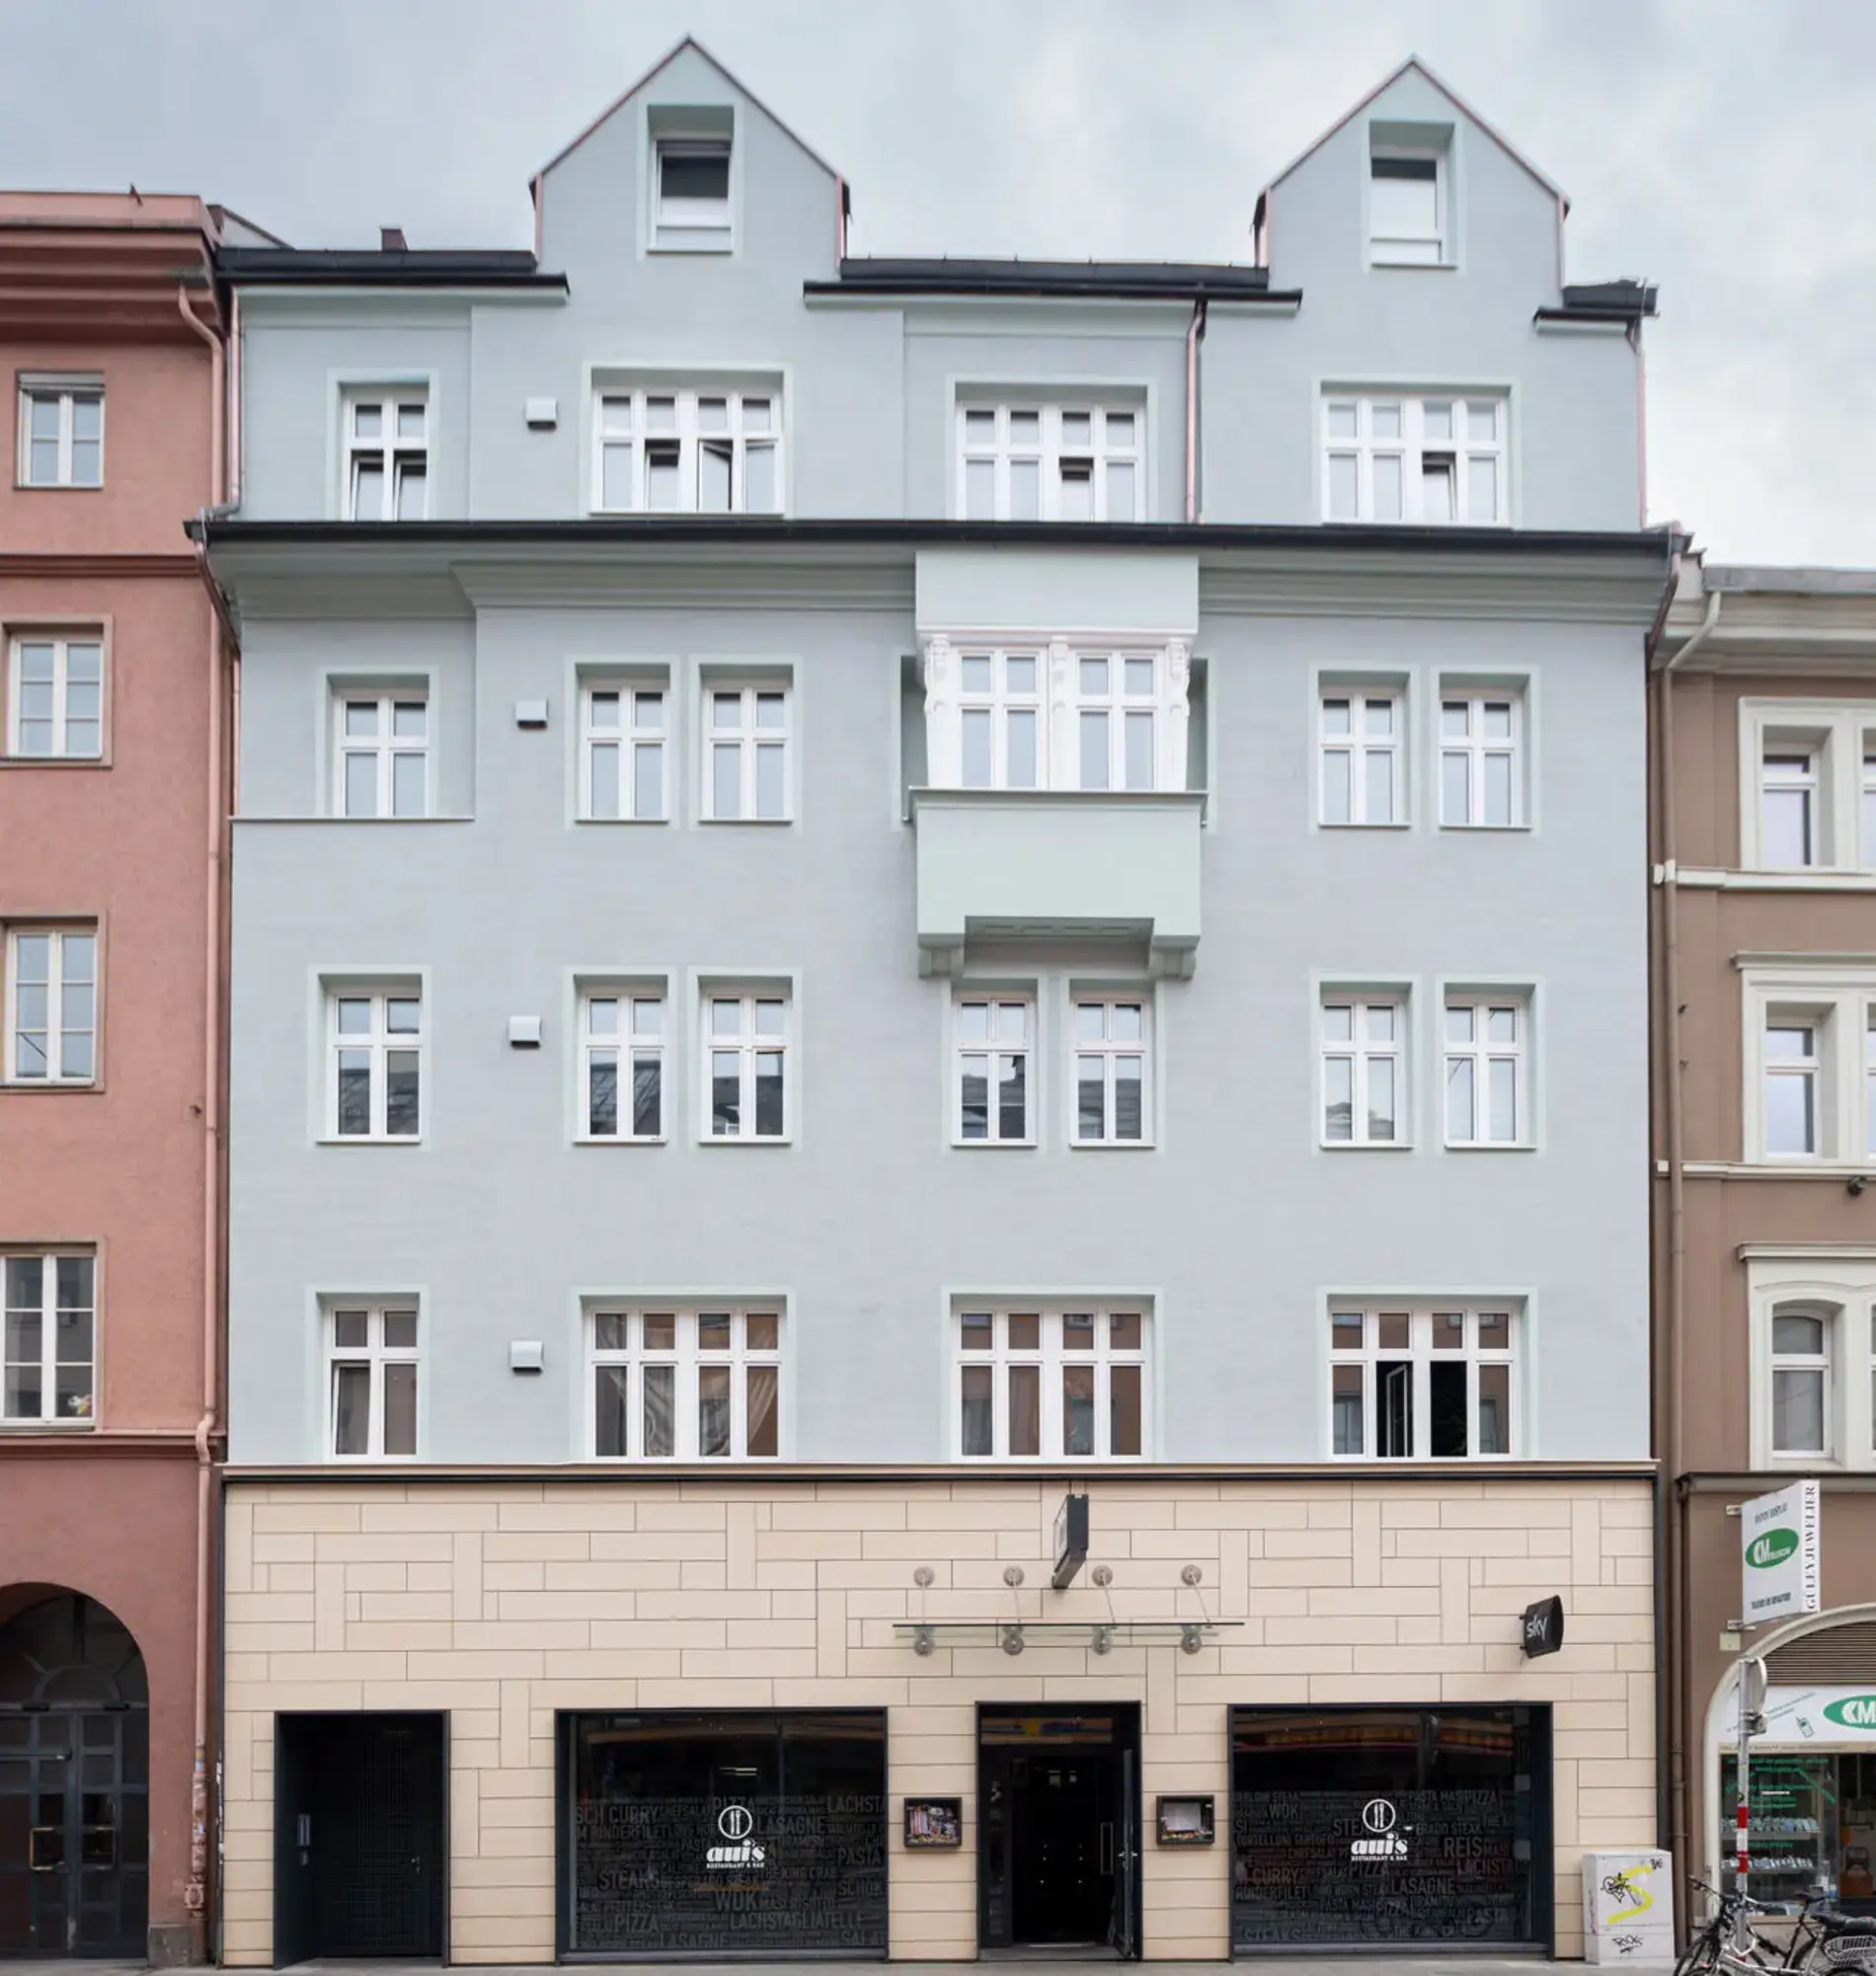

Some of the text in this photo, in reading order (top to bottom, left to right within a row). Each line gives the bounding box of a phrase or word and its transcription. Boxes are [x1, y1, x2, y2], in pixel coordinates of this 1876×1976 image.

[1526, 1615, 1548, 1641] sky
[609, 1805, 659, 1825] CURRY
[1269, 1803, 1299, 1819] WOK
[757, 1815, 824, 1835] LASAGNE
[838, 1847, 882, 1865] PASTA
[1444, 1837, 1482, 1858] REIS
[598, 1870, 659, 1890] STEAKS
[1252, 1867, 1299, 1884] CURRY
[1391, 1877, 1454, 1895] LASAGNE
[715, 1889, 757, 1912] WOK
[614, 1913, 659, 1933] PIZZA
